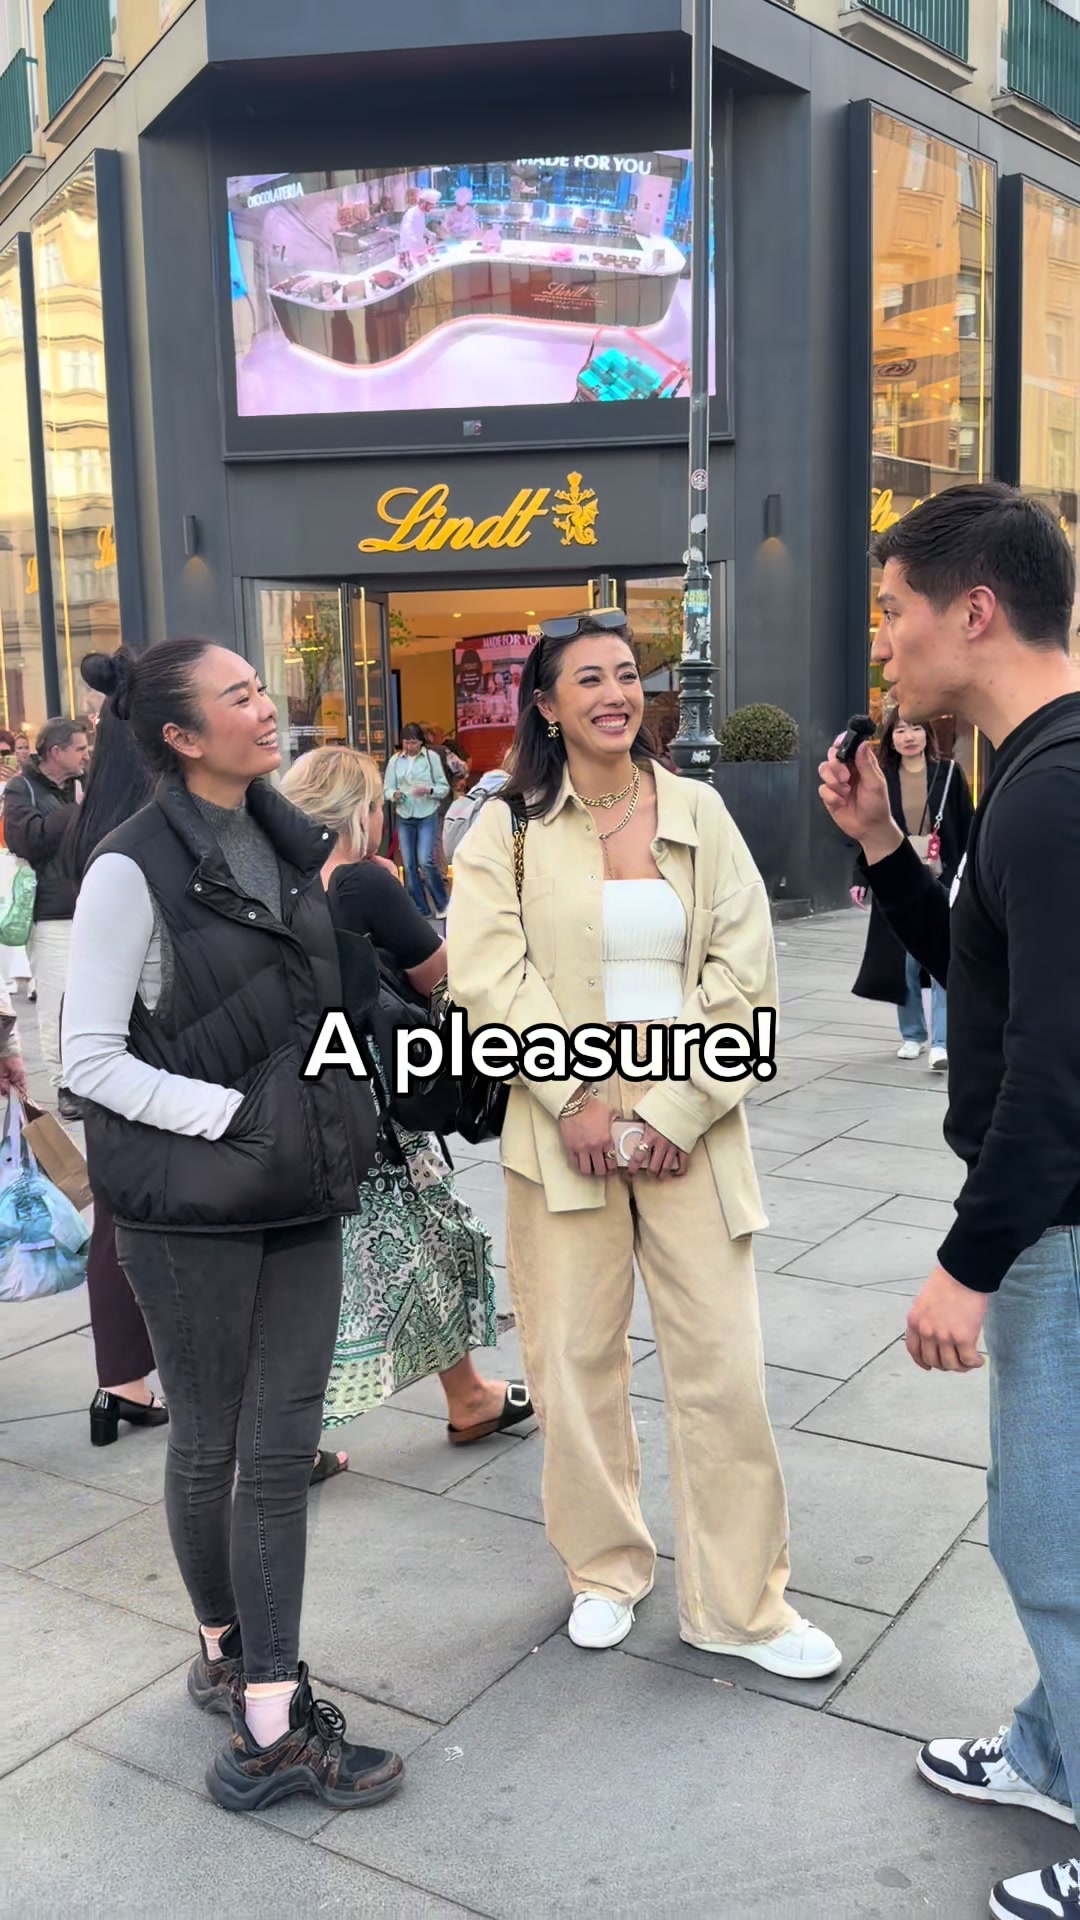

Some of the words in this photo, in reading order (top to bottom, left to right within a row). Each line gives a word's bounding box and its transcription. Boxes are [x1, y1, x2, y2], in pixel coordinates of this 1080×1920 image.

[573, 154, 610, 171] FOR
[612, 156, 652, 175] YOU
[357, 483, 551, 553] Lindt
[501, 634, 521, 646] FOR
[521, 634, 539, 646] YO
